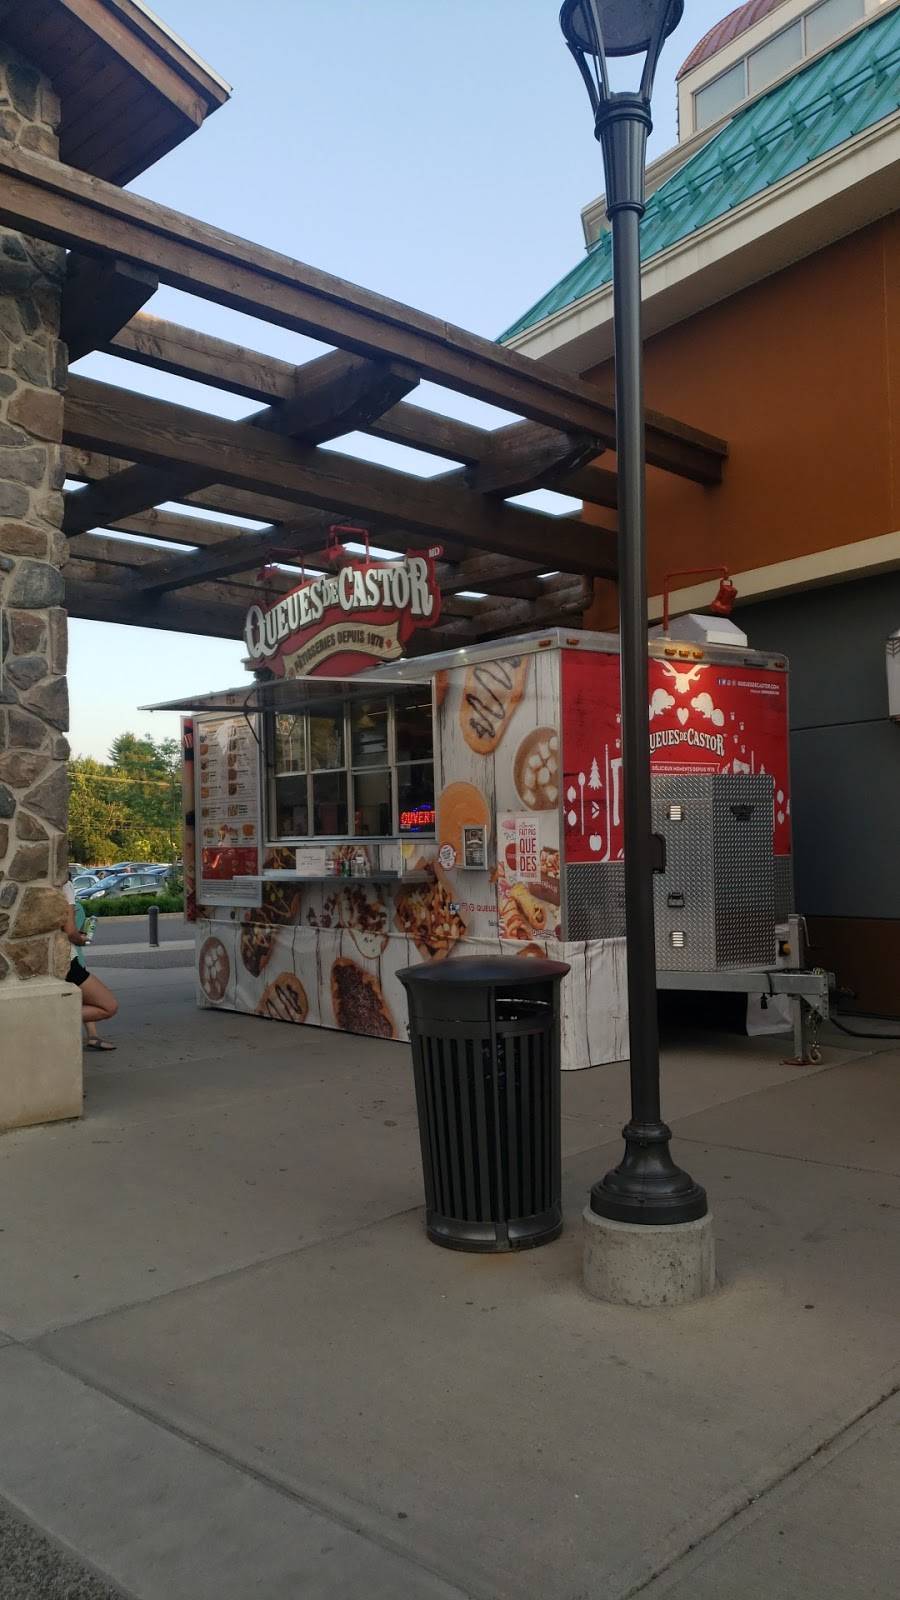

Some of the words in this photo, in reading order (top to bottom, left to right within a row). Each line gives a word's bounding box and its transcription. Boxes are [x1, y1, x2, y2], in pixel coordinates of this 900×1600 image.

[244, 582, 325, 658] QUEUES
[322, 581, 339, 607] DE
[338, 557, 434, 617] CASTOR
[337, 630, 365, 645] DEPUIS
[649, 730, 680, 754] UEUES
[687, 728, 725, 757] CASTOR
[401, 810, 435, 825] OUVERT
[519, 838, 537, 854] QUE
[519, 855, 537, 872] DES
